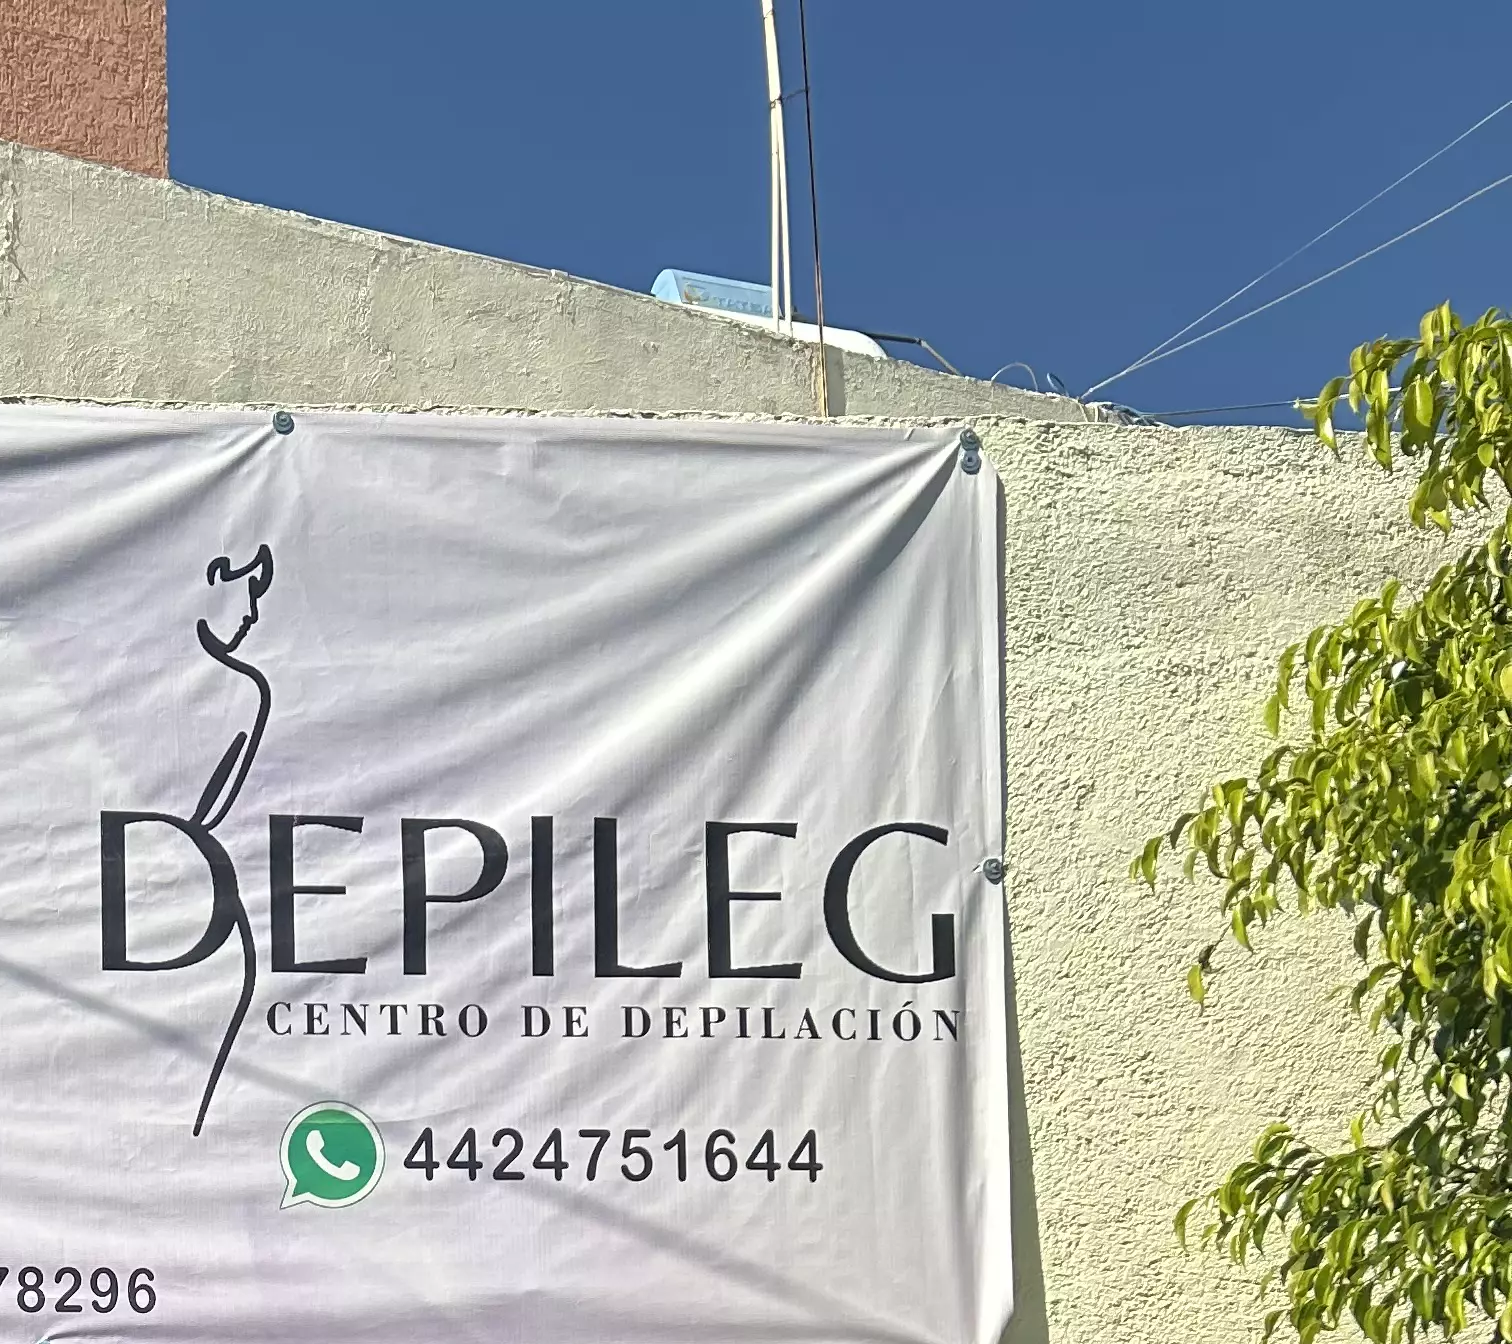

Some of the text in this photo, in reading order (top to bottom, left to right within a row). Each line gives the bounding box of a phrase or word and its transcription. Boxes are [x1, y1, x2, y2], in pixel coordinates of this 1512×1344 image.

[100, 811, 956, 984] DEPILEG
[267, 1001, 962, 1043] CENTRO DE DEPILACIÓN
[403, 1127, 824, 1183] 4424751644
